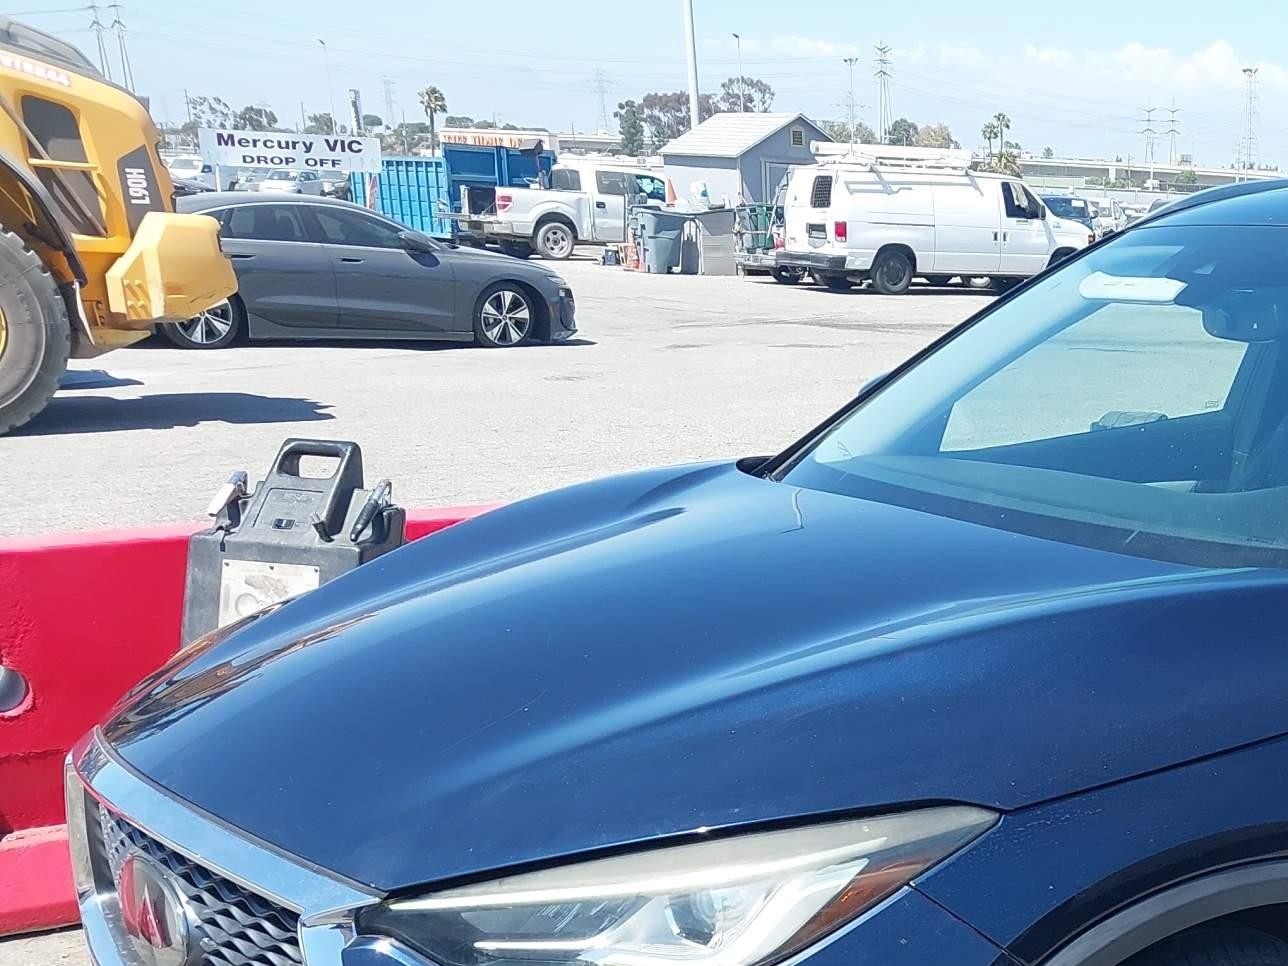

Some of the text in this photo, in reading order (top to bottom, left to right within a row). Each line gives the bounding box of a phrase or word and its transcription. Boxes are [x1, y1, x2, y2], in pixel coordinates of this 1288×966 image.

[216, 133, 364, 154] Mercury VIC
[242, 155, 342, 168] DROP OFF
[125, 168, 150, 205] L90H
